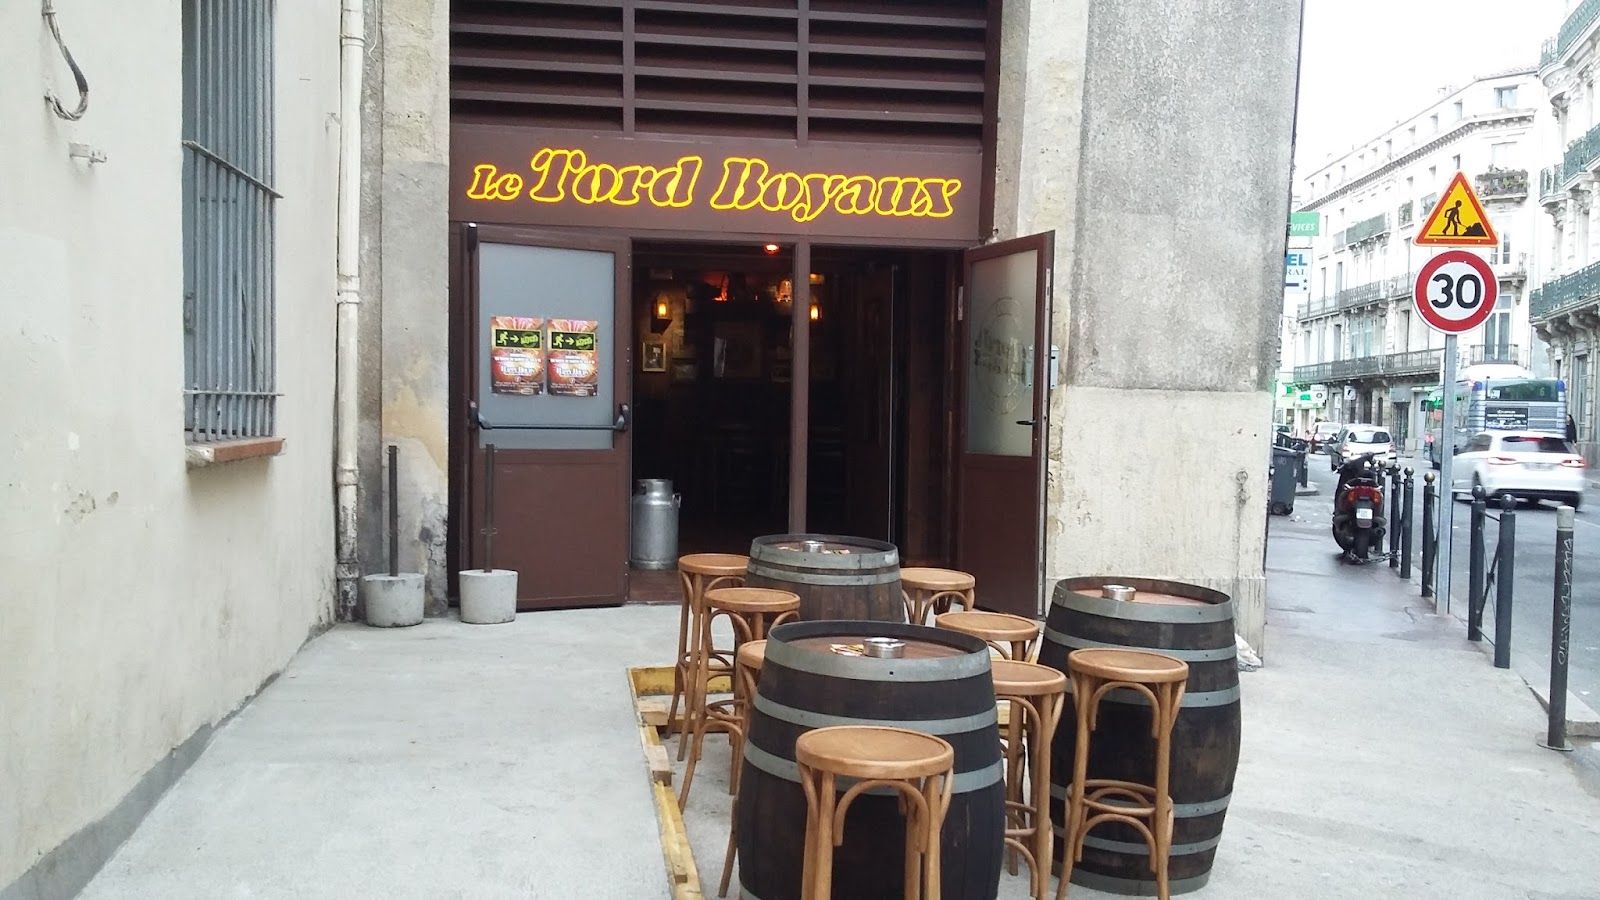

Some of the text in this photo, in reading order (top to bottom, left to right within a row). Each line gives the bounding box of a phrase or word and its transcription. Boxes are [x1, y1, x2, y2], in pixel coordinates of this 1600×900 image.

[465, 147, 962, 223] Le Tord Boyaux
[1430, 273, 1482, 309] 30
